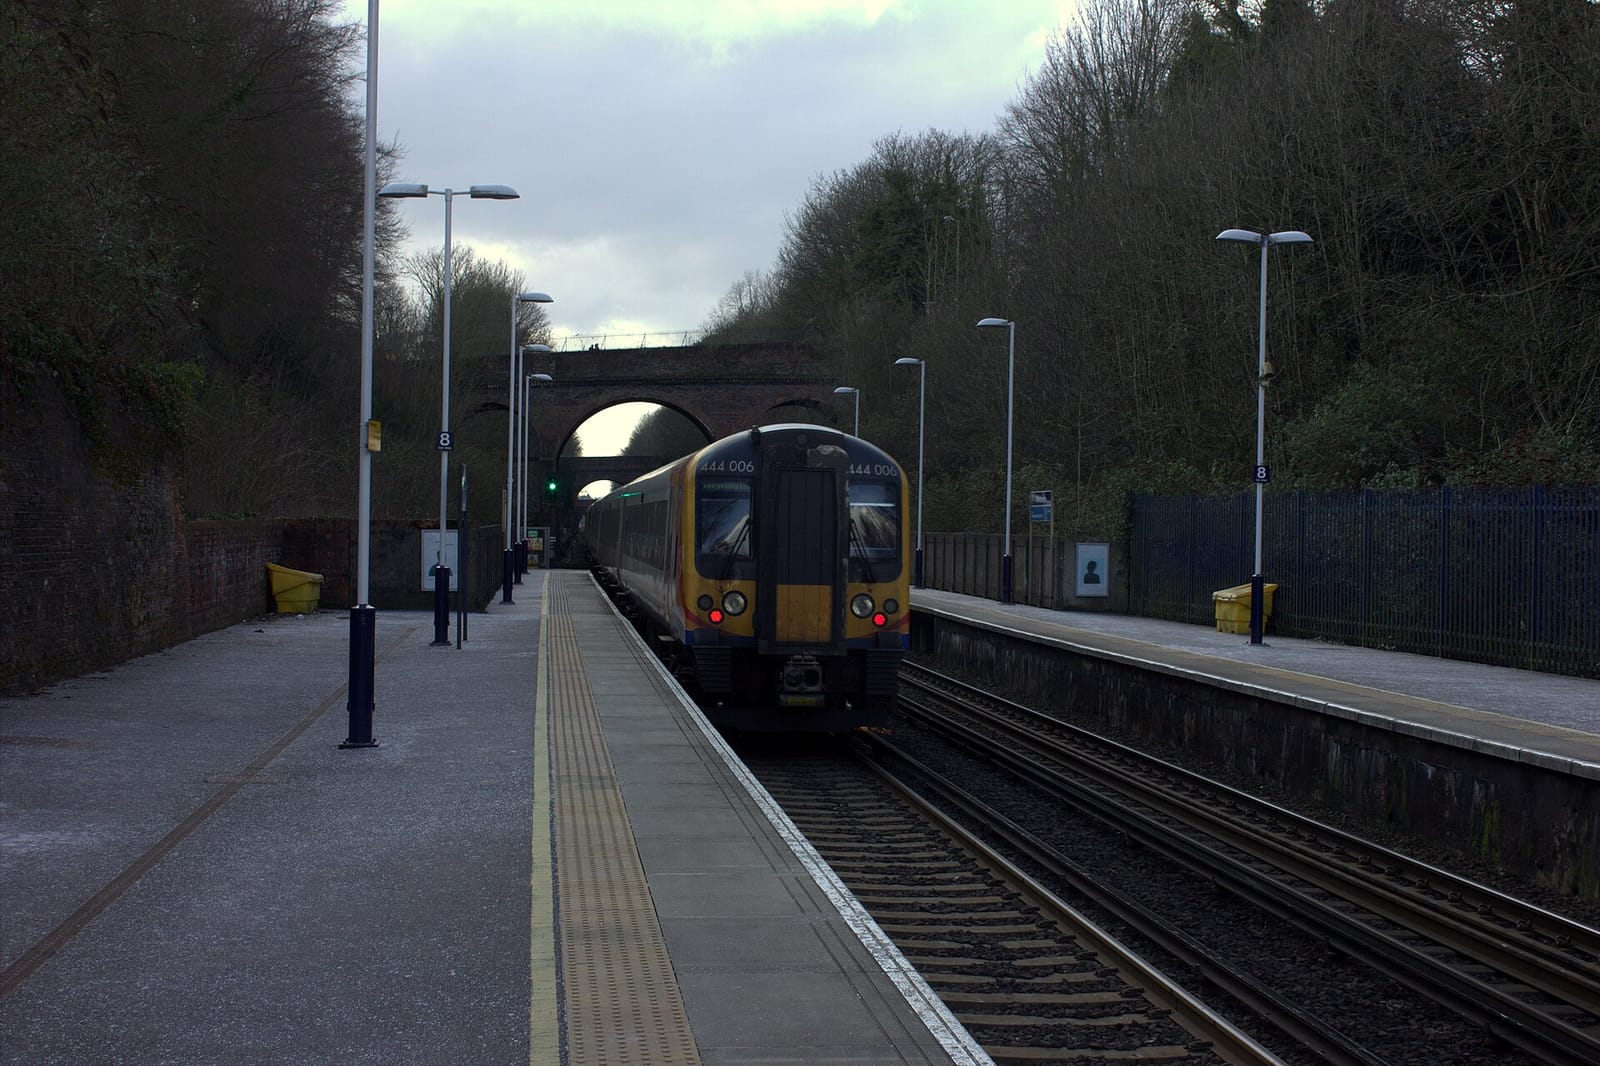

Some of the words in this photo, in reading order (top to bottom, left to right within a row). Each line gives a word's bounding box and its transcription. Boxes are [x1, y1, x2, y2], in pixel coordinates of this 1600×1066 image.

[439, 433, 451, 446] 8
[700, 461, 725, 471] 444
[729, 460, 754, 472] 006
[848, 463, 870, 474] 444
[874, 464, 897, 476] 006
[1256, 466, 1267, 479] 8
